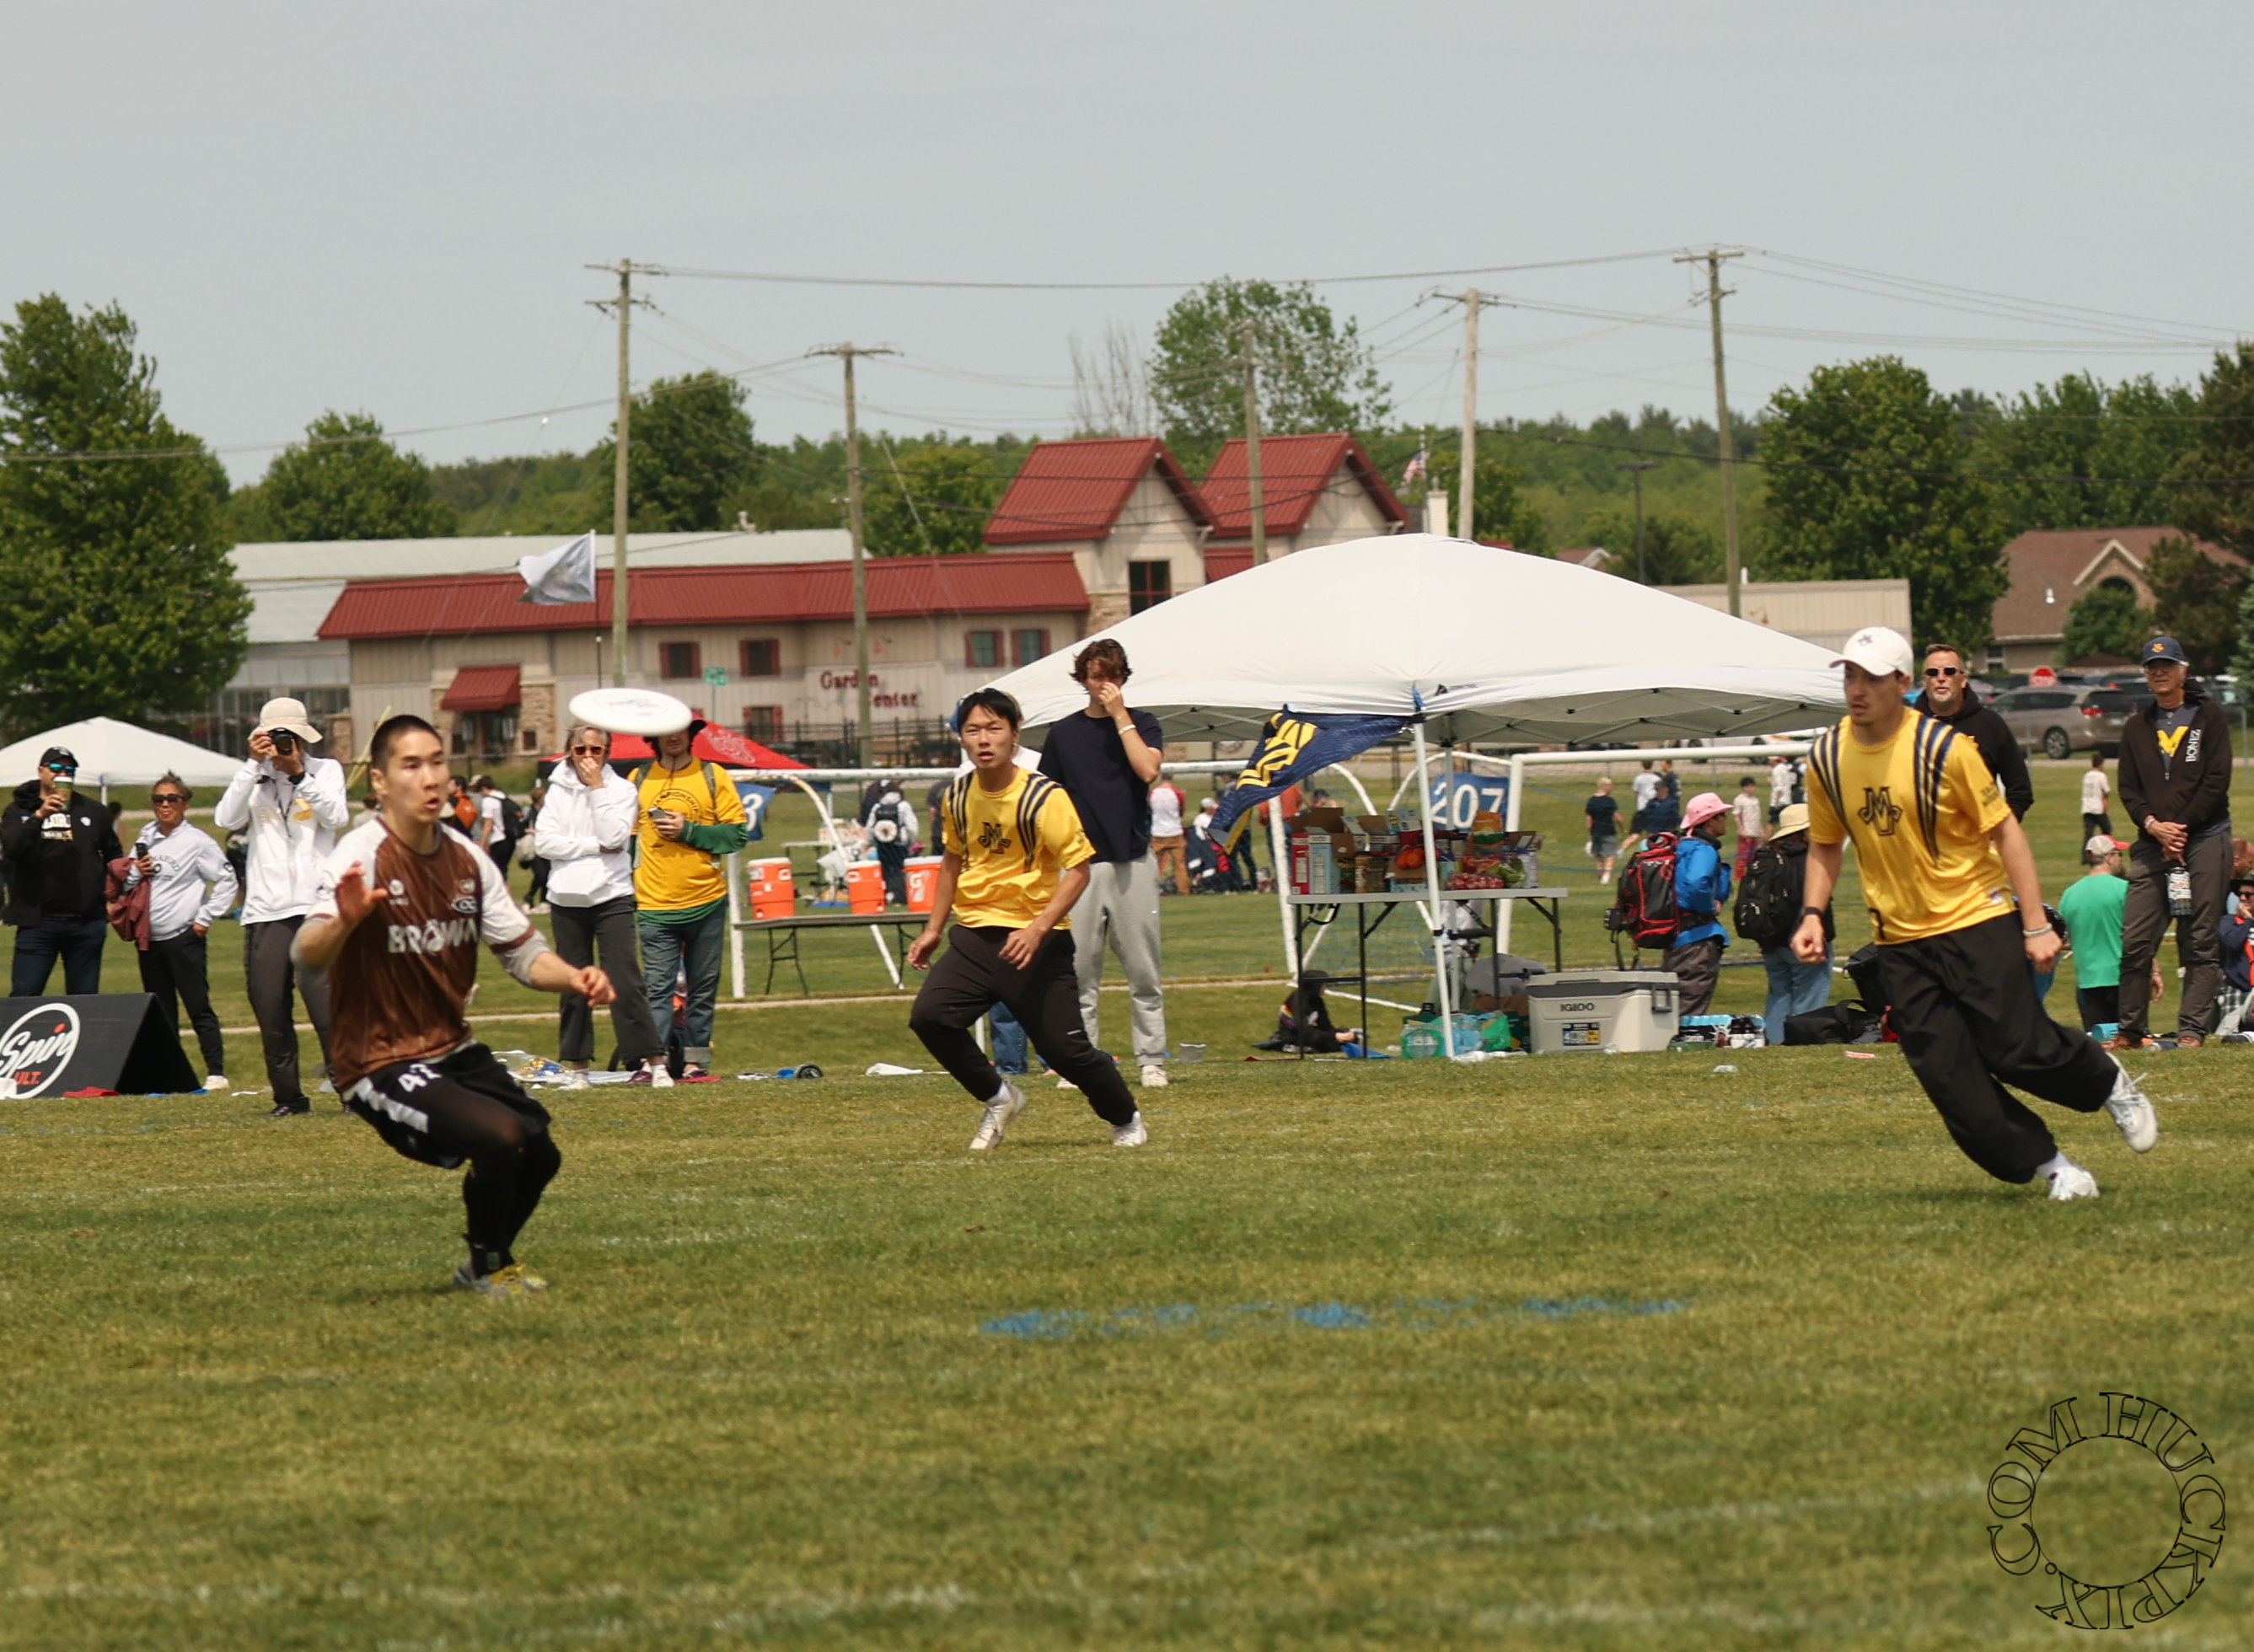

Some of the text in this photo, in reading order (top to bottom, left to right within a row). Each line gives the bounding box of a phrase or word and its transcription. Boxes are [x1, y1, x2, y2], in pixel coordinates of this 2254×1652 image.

[820, 669, 879, 689] Gardn
[868, 691, 917, 708] enter
[1430, 781, 1505, 829] 207
[1560, 1001, 1596, 1011] IGLOO
[0, 1022, 73, 1079] Spin
